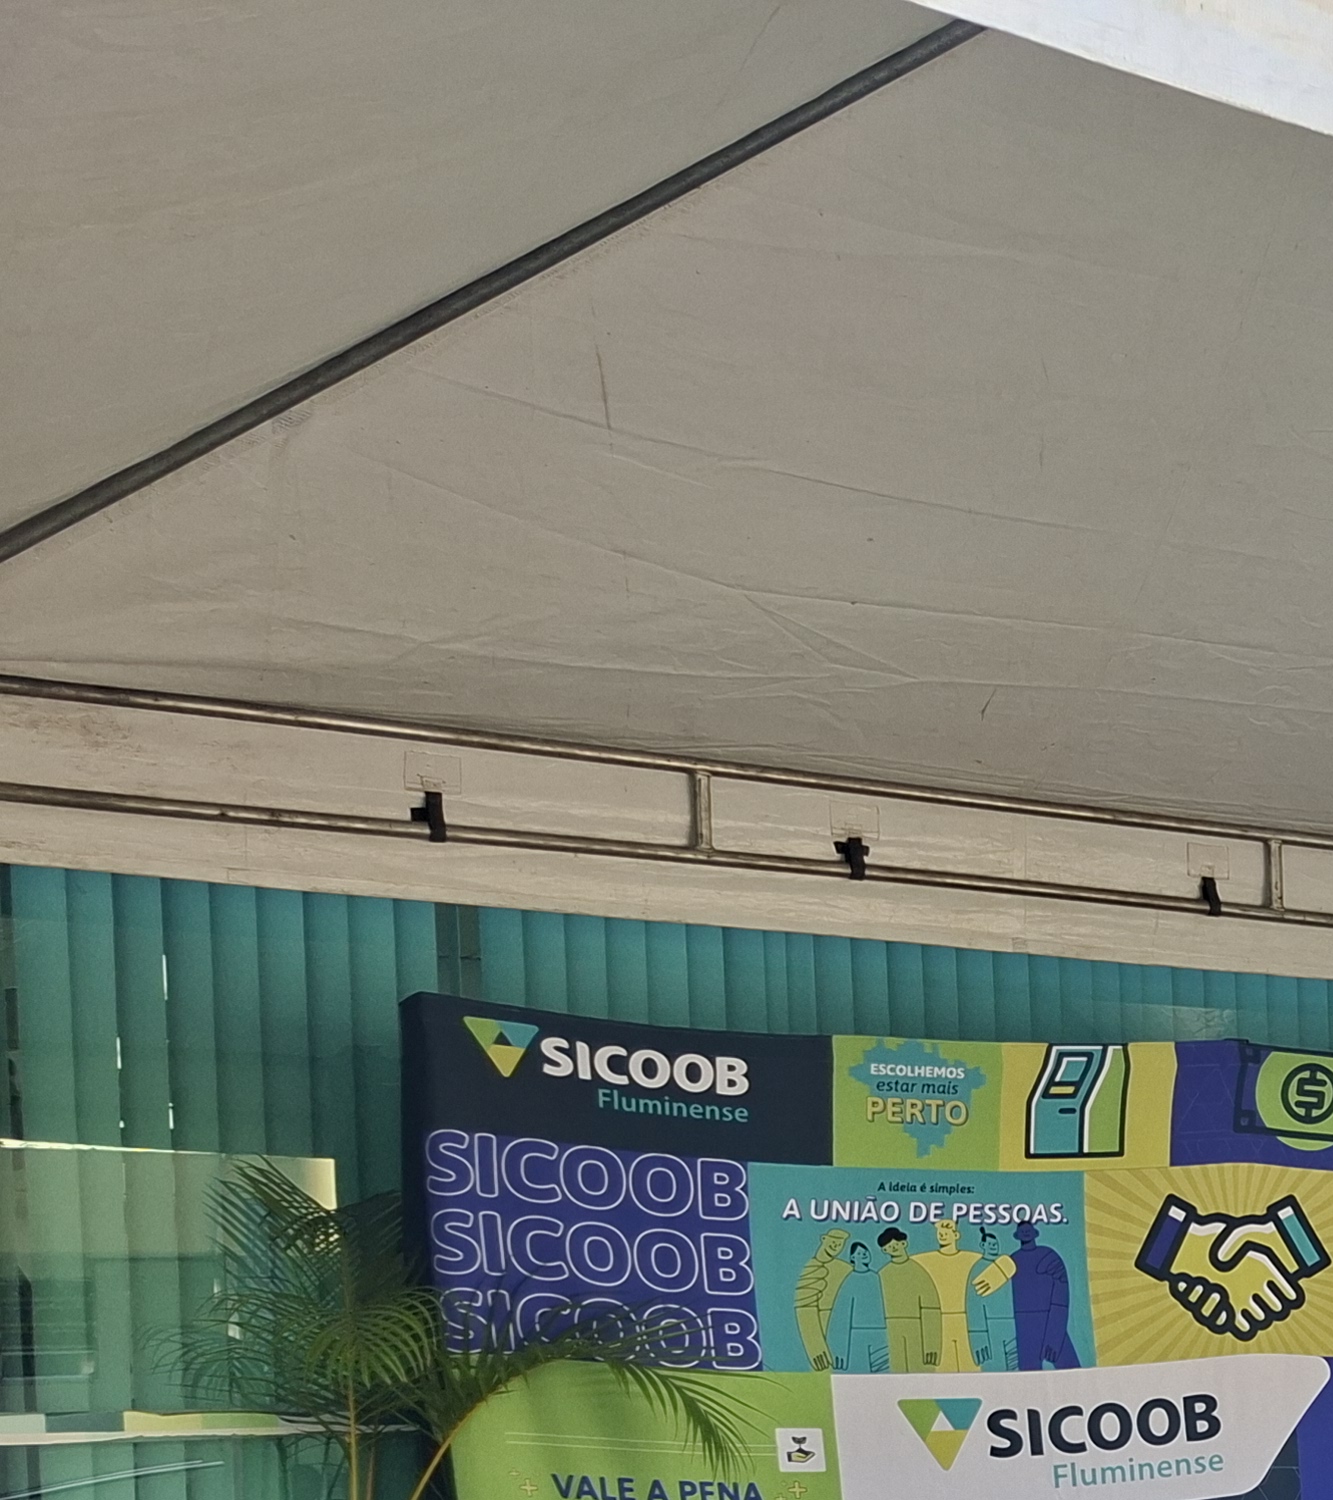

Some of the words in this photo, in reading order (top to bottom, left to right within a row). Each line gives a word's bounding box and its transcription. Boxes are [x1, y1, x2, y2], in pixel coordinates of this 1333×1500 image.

[540, 1036, 750, 1096] SICOOB
[870, 1063, 965, 1079] ESCOLHEMOS
[597, 1087, 749, 1123] Fluminense
[876, 1080, 917, 1093] estar
[922, 1081, 959, 1095] mais
[866, 1096, 969, 1126] PERTO
[425, 1129, 750, 1221] SICOOB
[877, 1182, 887, 1192] A
[889, 1181, 917, 1193] ideia
[920, 1182, 927, 1193] é
[929, 1181, 976, 1196] simples:
[782, 1197, 803, 1221] A
[809, 1195, 901, 1222] UNIÃO
[908, 1201, 946, 1223] DE
[952, 1202, 1070, 1225] PESSOAS.
[430, 1207, 755, 1296] SICOOB
[439, 1286, 763, 1370] SICOOB
[985, 1393, 1223, 1459] SICOOB
[1051, 1450, 1226, 1490] Fluminense
